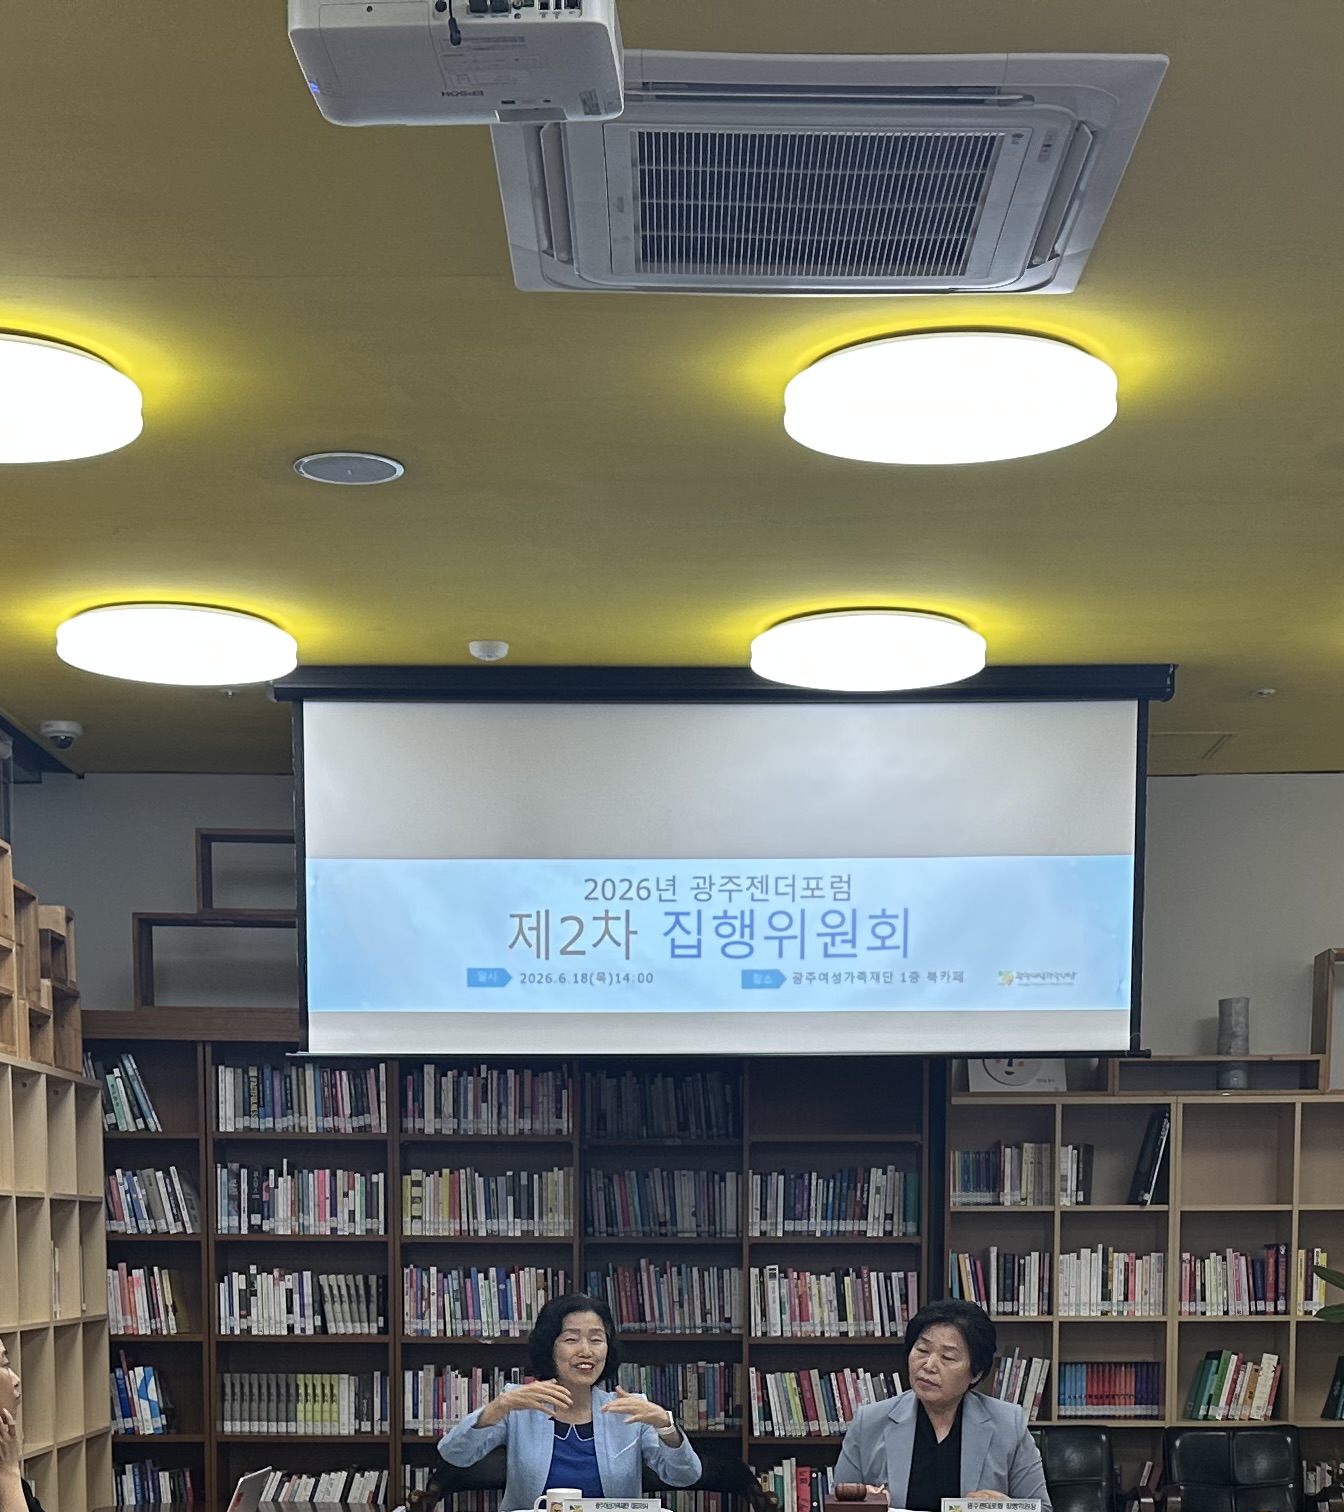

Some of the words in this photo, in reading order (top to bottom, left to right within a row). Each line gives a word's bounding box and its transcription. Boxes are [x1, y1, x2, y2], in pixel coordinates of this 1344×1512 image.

[441, 89, 485, 97] EPSON
[583, 875, 678, 903] 2026년
[689, 873, 853, 903] 광주젠더포럼
[508, 908, 638, 961] 제2차
[662, 907, 909, 960] 집행위원회
[792, 970, 894, 985] 광주여성가족재단
